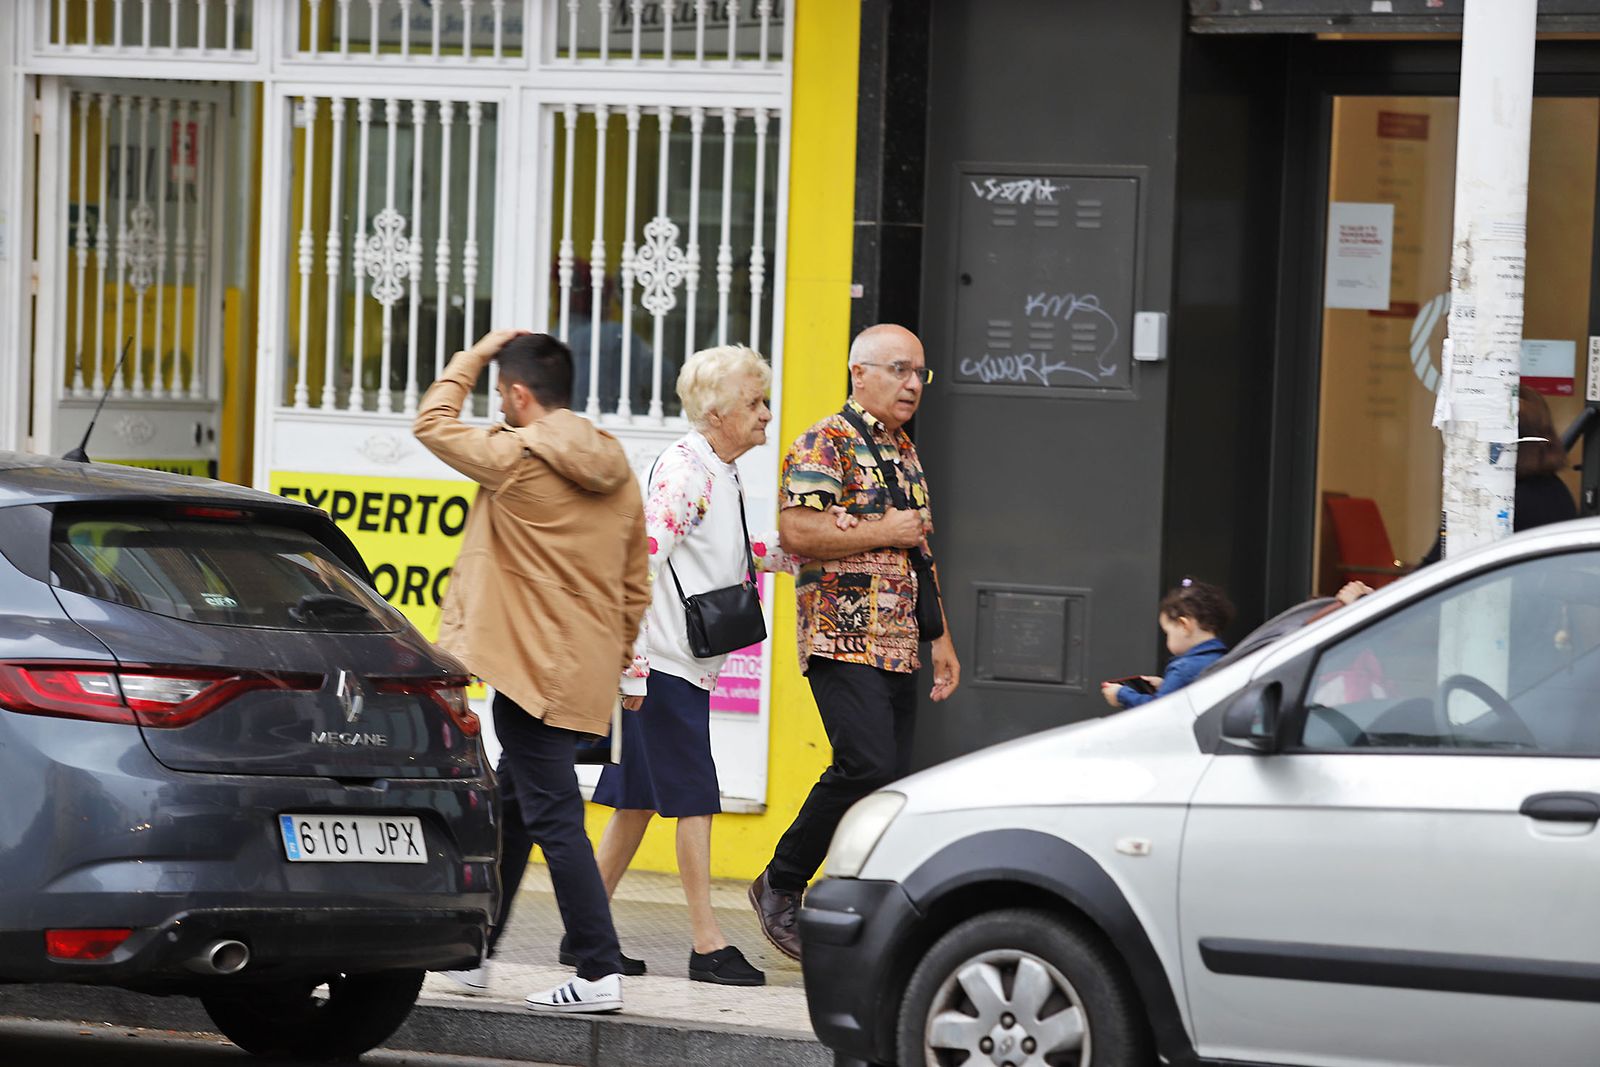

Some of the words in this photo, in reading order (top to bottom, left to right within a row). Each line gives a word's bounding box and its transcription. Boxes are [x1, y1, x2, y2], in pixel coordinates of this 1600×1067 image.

[279, 487, 470, 537] PERTO
[311, 731, 388, 747] MEGANE
[299, 821, 364, 856] 6161
[375, 821, 420, 857] JPX
